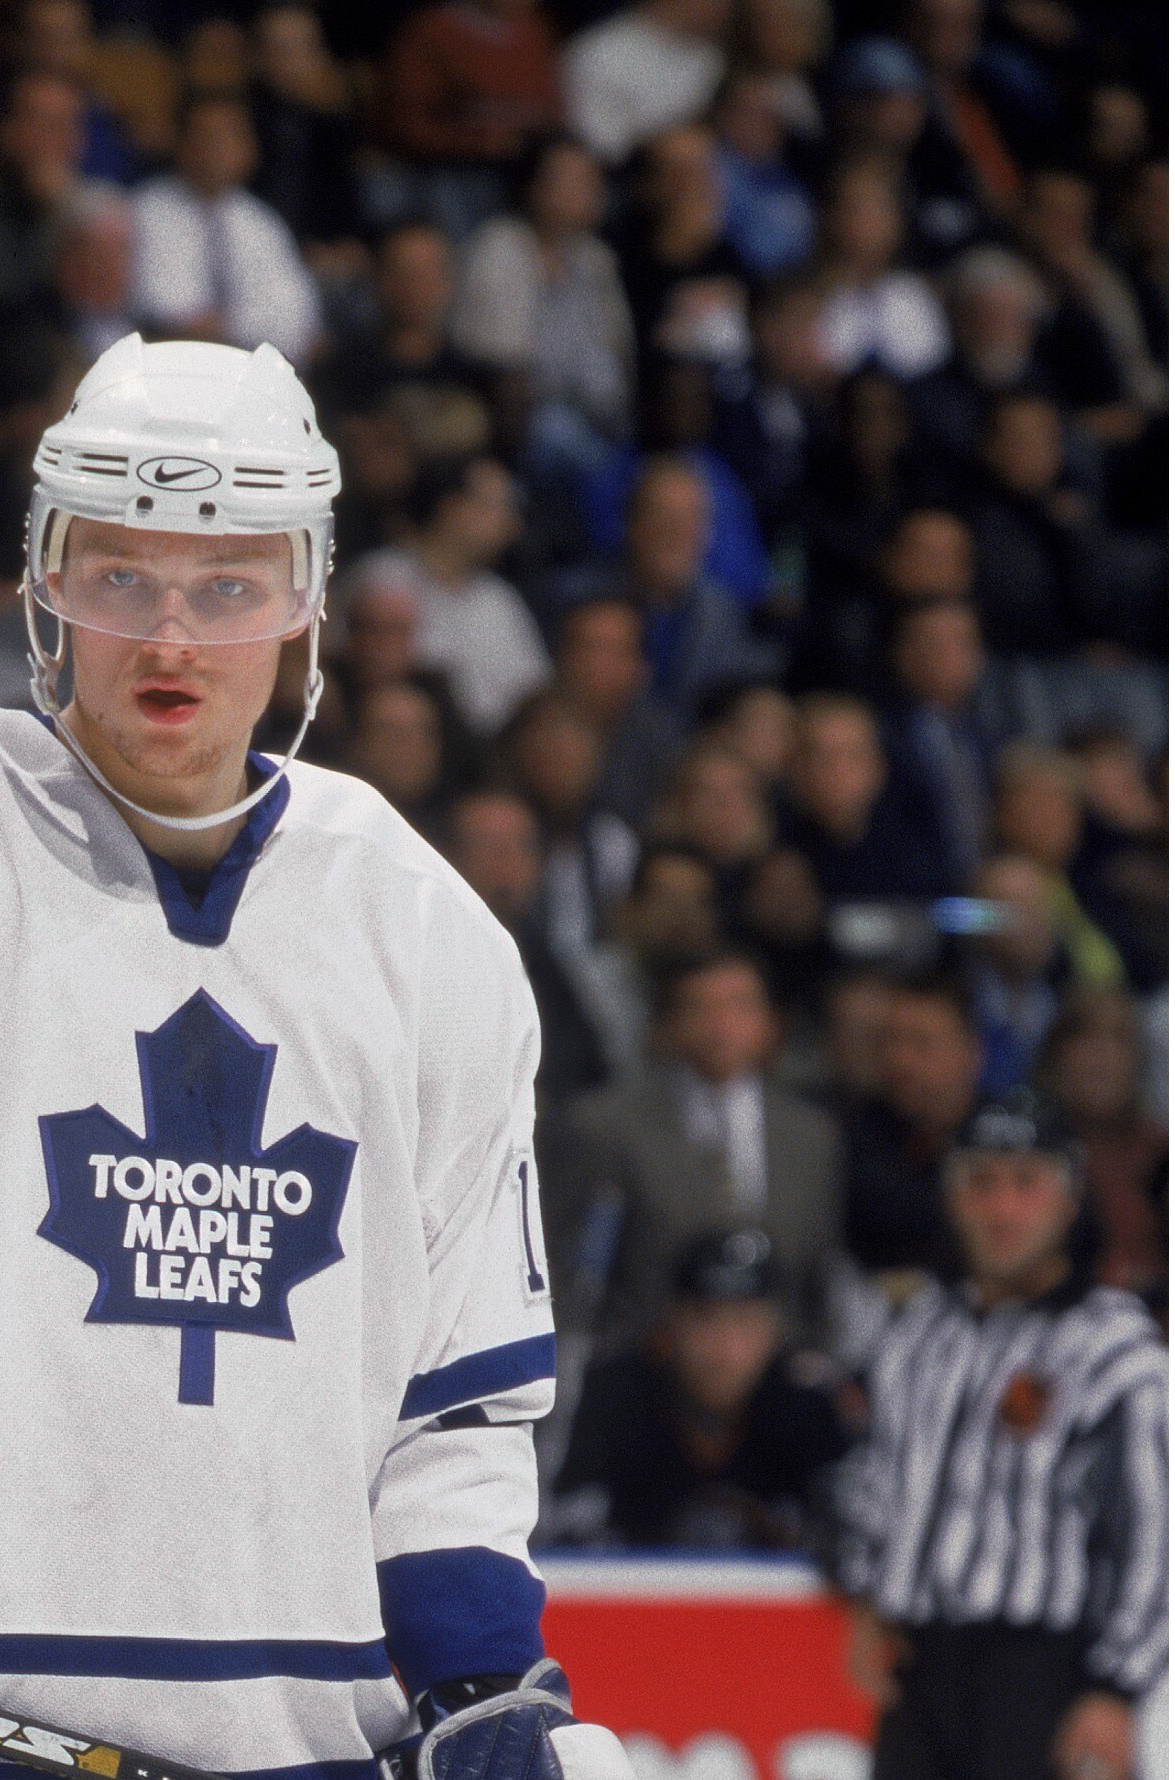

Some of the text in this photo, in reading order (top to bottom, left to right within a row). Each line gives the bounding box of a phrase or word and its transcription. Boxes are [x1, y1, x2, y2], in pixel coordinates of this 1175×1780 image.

[89, 1154, 313, 1216] TORONTO
[123, 1203, 274, 1259] MAPLE
[134, 1252, 263, 1308] LEAFS
